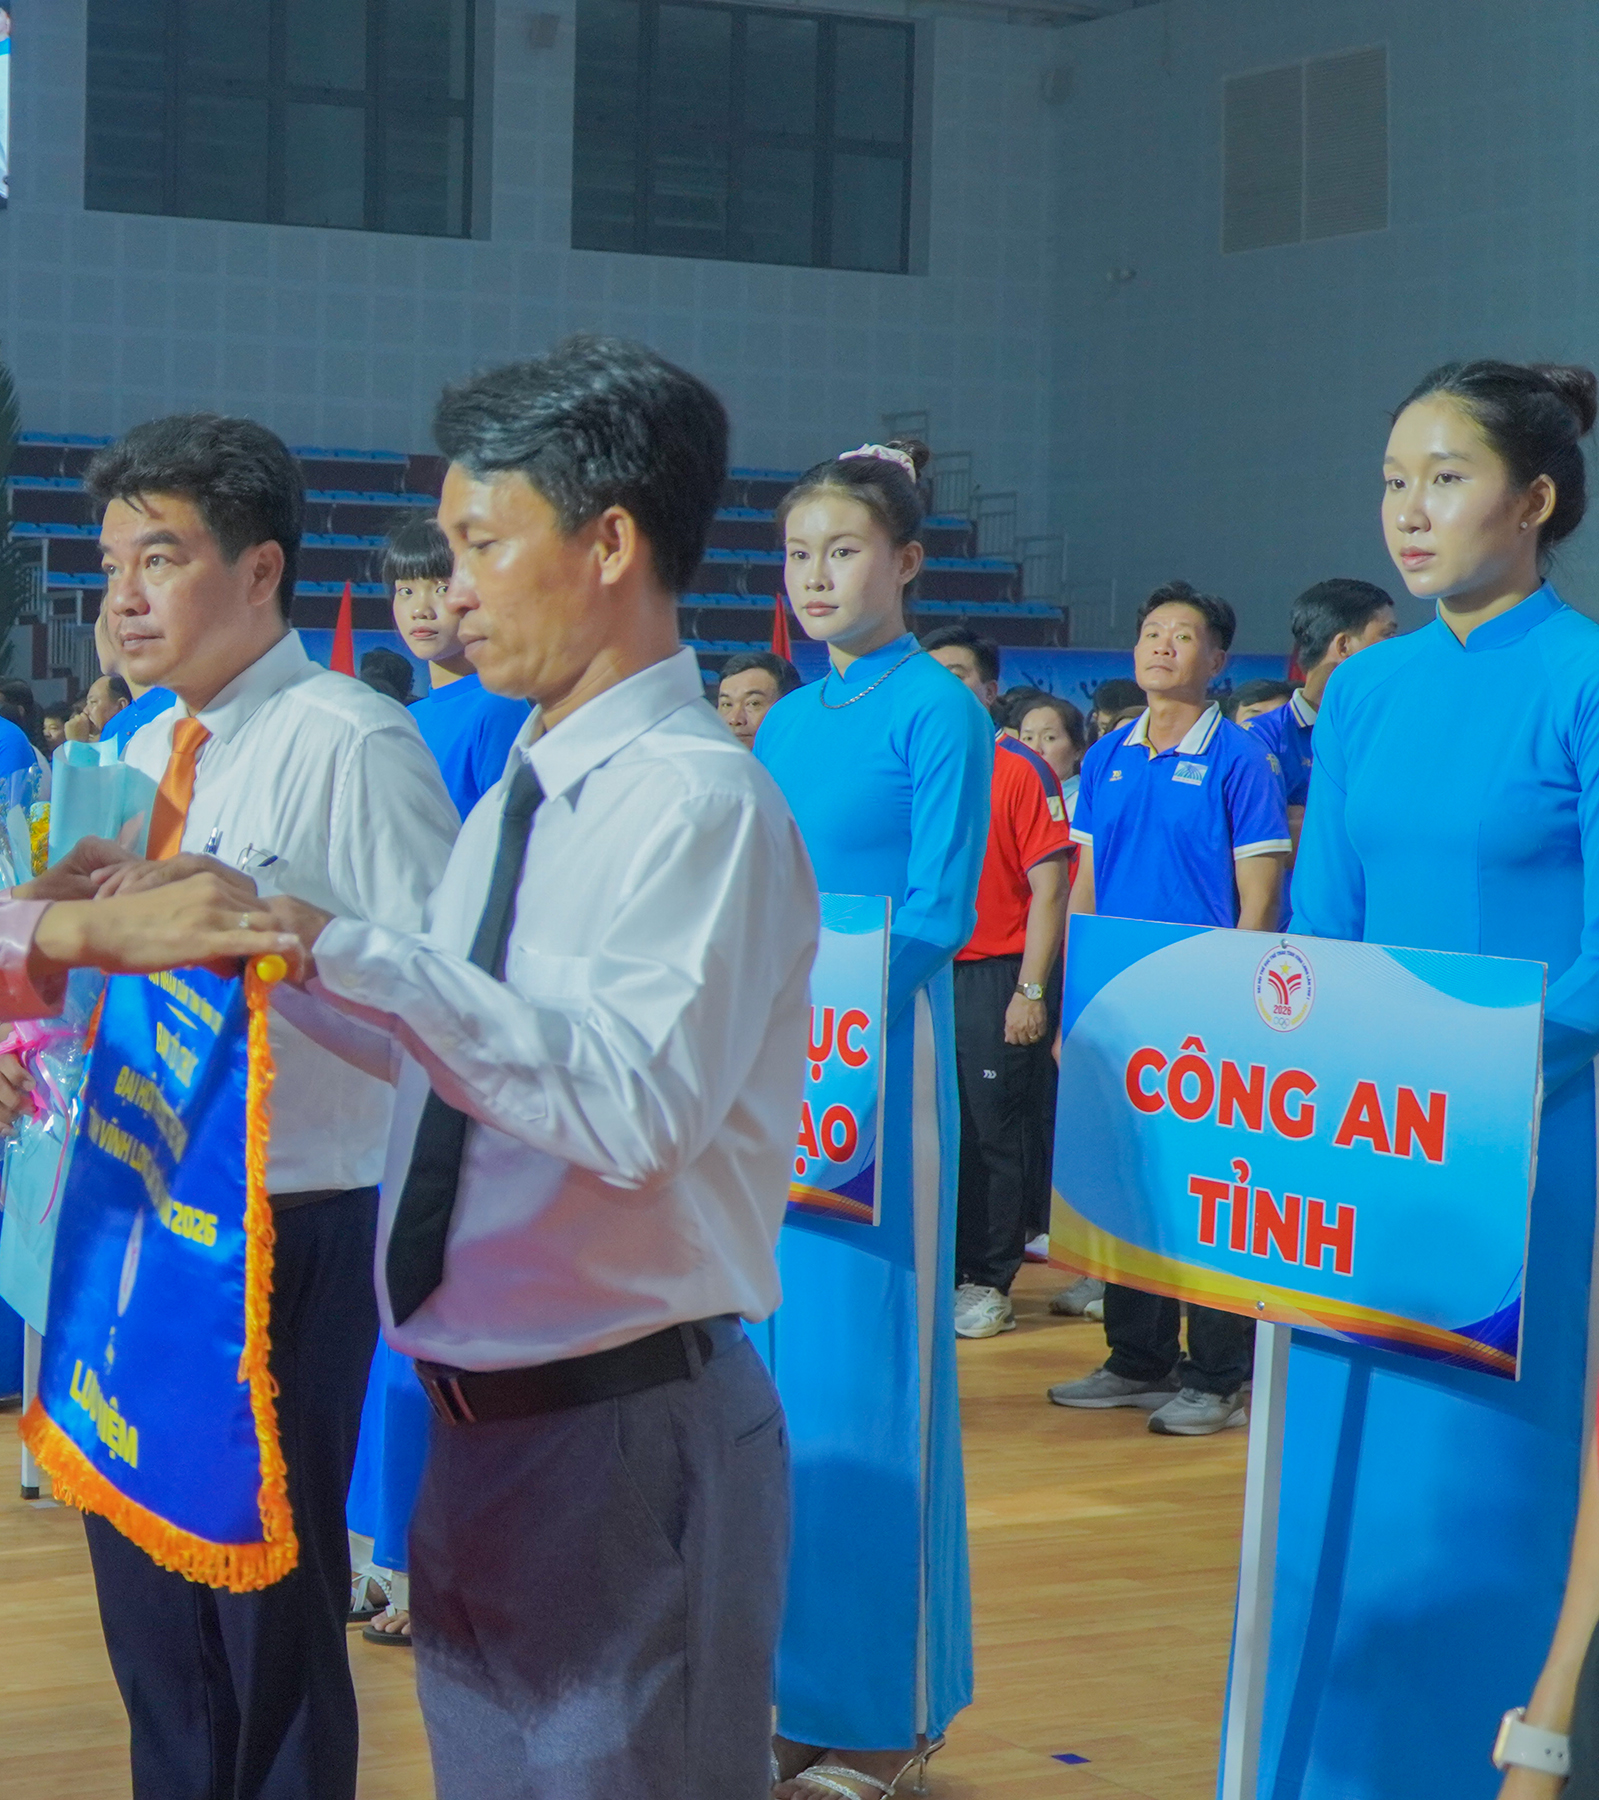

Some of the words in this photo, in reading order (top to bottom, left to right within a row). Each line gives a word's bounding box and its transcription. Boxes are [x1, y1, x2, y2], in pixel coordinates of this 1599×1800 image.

[1273, 1004, 1292, 1016] 2026
[1125, 1035, 1317, 1139] CÔNG
[1334, 1081, 1447, 1163] AN
[1188, 1158, 1356, 1275] TỈNH
